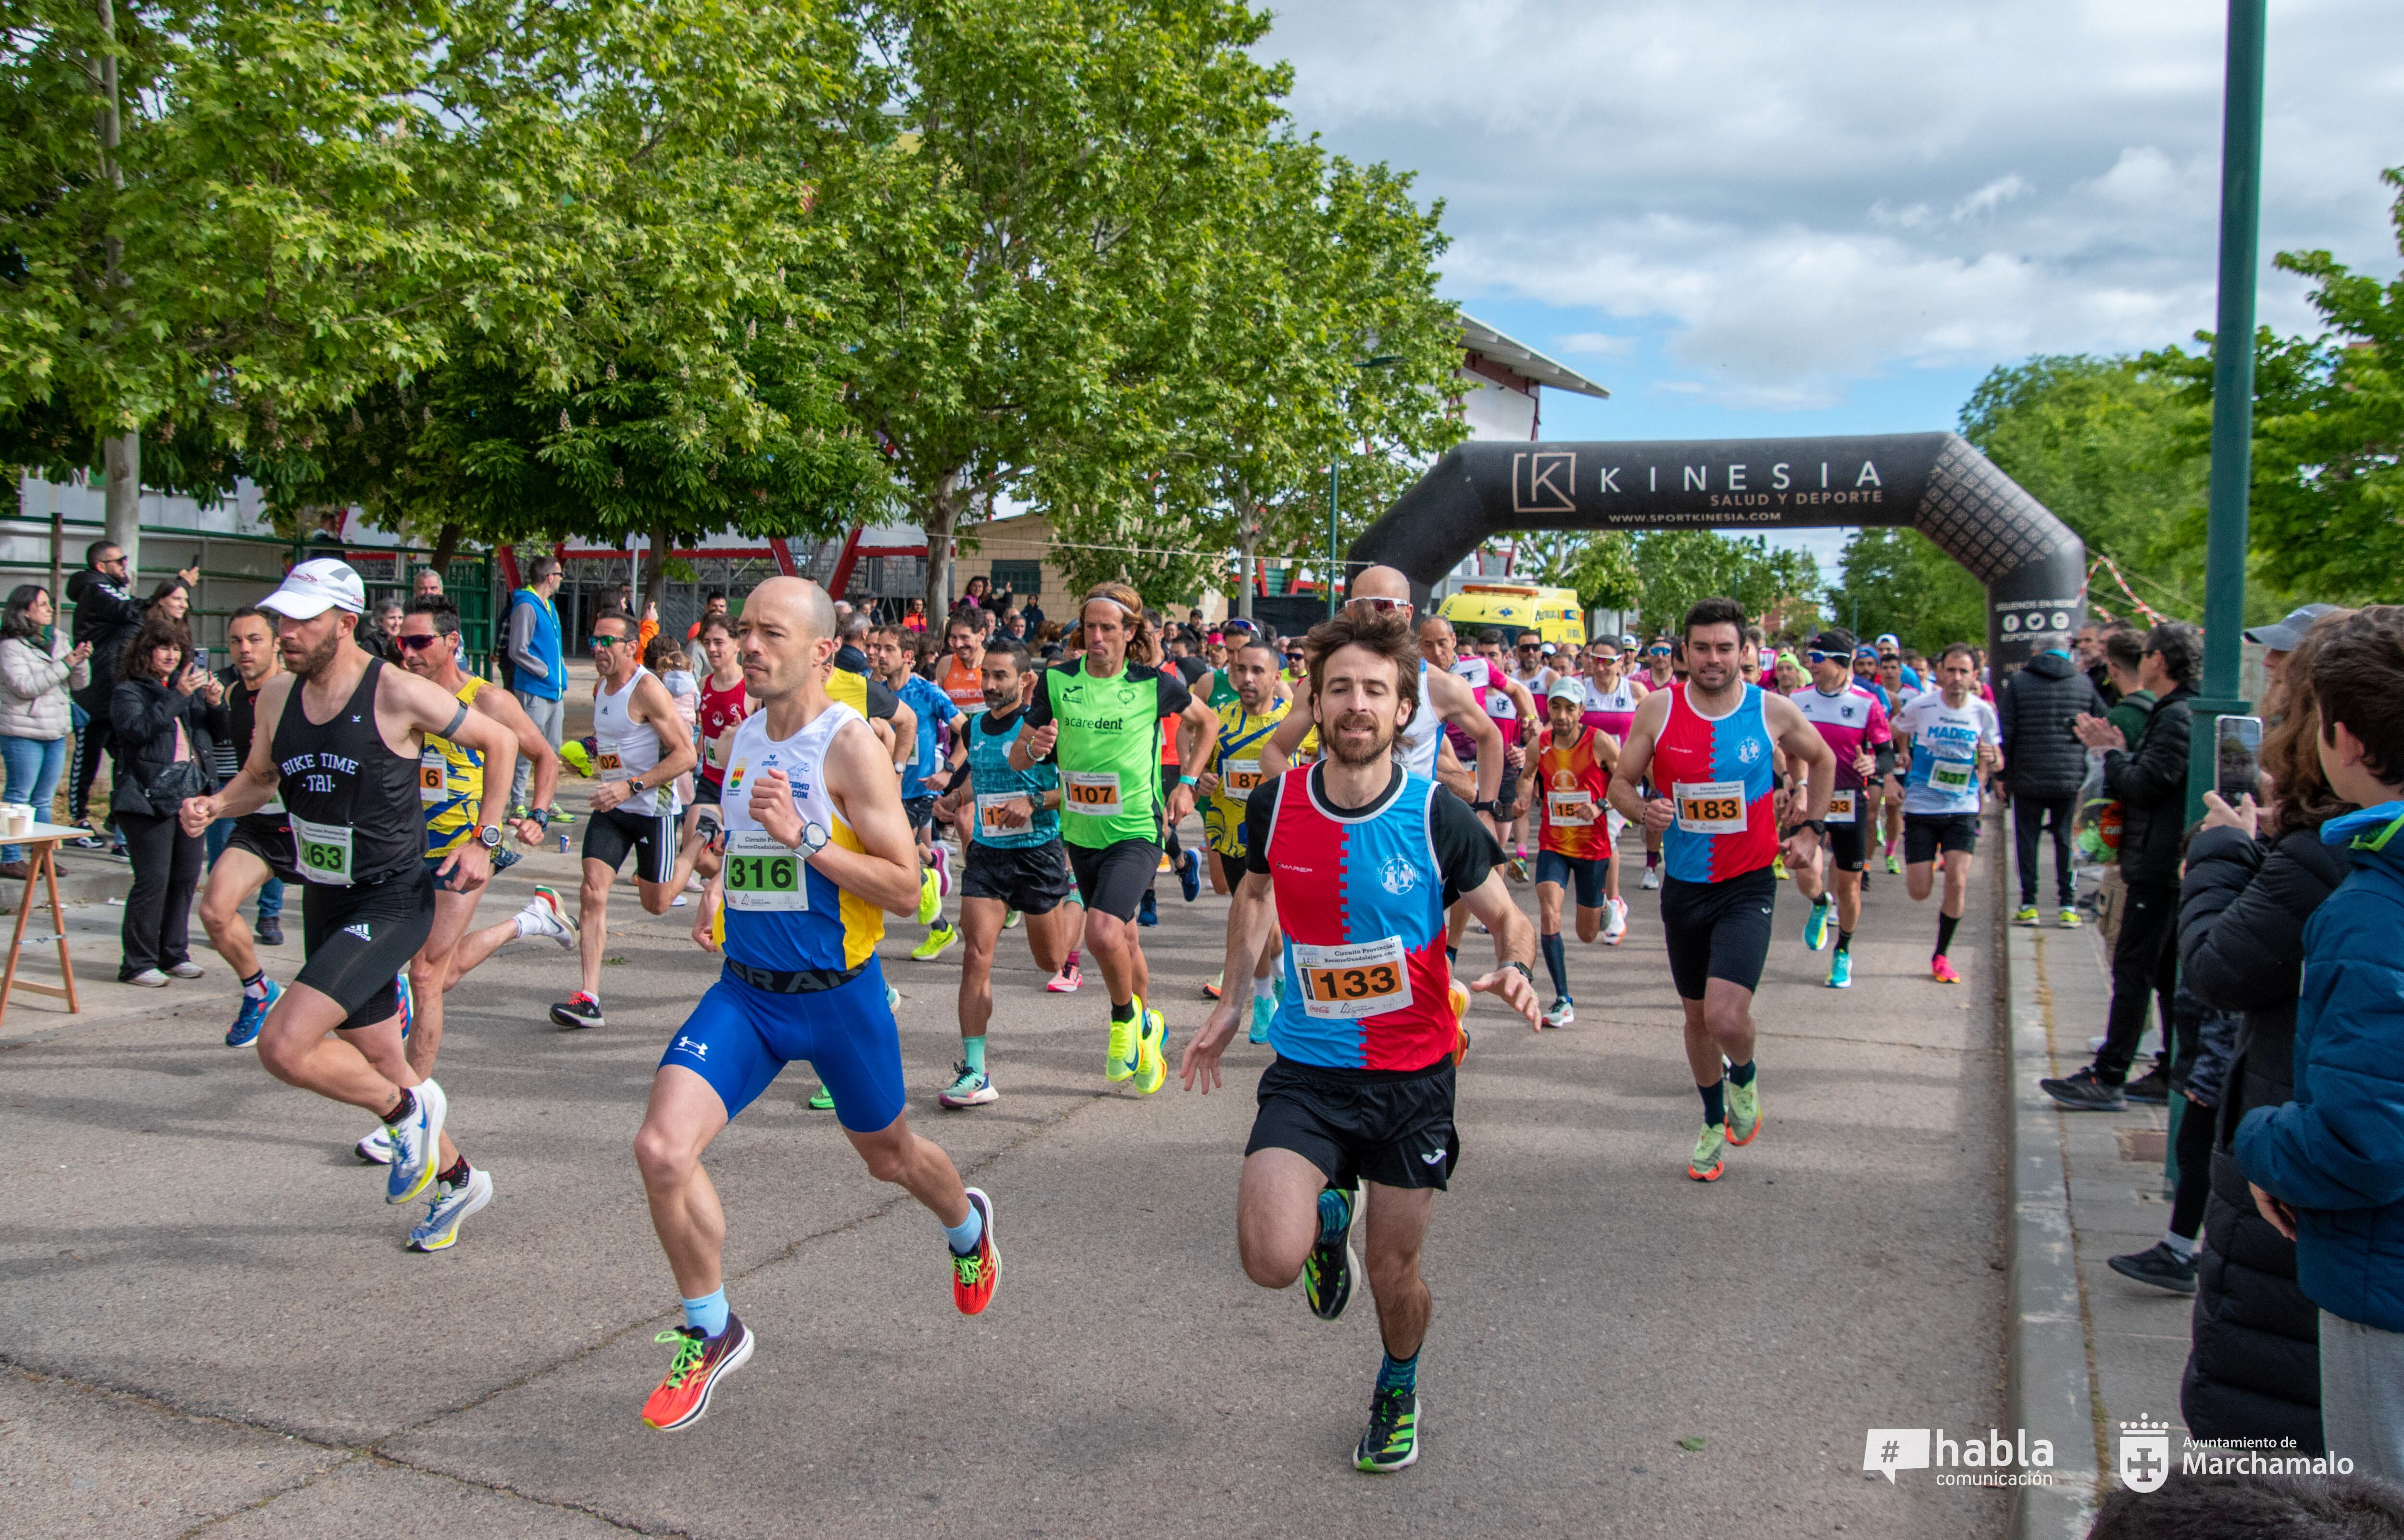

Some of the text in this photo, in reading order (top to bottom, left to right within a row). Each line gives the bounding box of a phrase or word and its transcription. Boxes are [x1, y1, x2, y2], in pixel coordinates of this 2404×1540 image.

[1600, 460, 1881, 493] KINESIA
[1710, 490, 1883, 506] SALUD Y DEPORTE
[1608, 512, 1781, 523] WWW.SPORTKINESIA.COM
[282, 753, 359, 776] BIKE TIME
[601, 755, 620, 769] 02
[426, 769, 439, 787] 6
[1239, 774, 1262, 788] 87
[789, 781, 809, 790] TISMO
[792, 789, 808, 799] CÓN
[1074, 786, 1112, 804] 107
[1557, 804, 1575, 816] 15
[1689, 800, 1737, 819] 183
[731, 858, 792, 889] 316
[343, 927, 372, 941] adidas
[1363, 943, 1395, 953] Provincial
[1325, 950, 1396, 963] RecorreGuadalajara.com
[1320, 966, 1396, 999] 133
